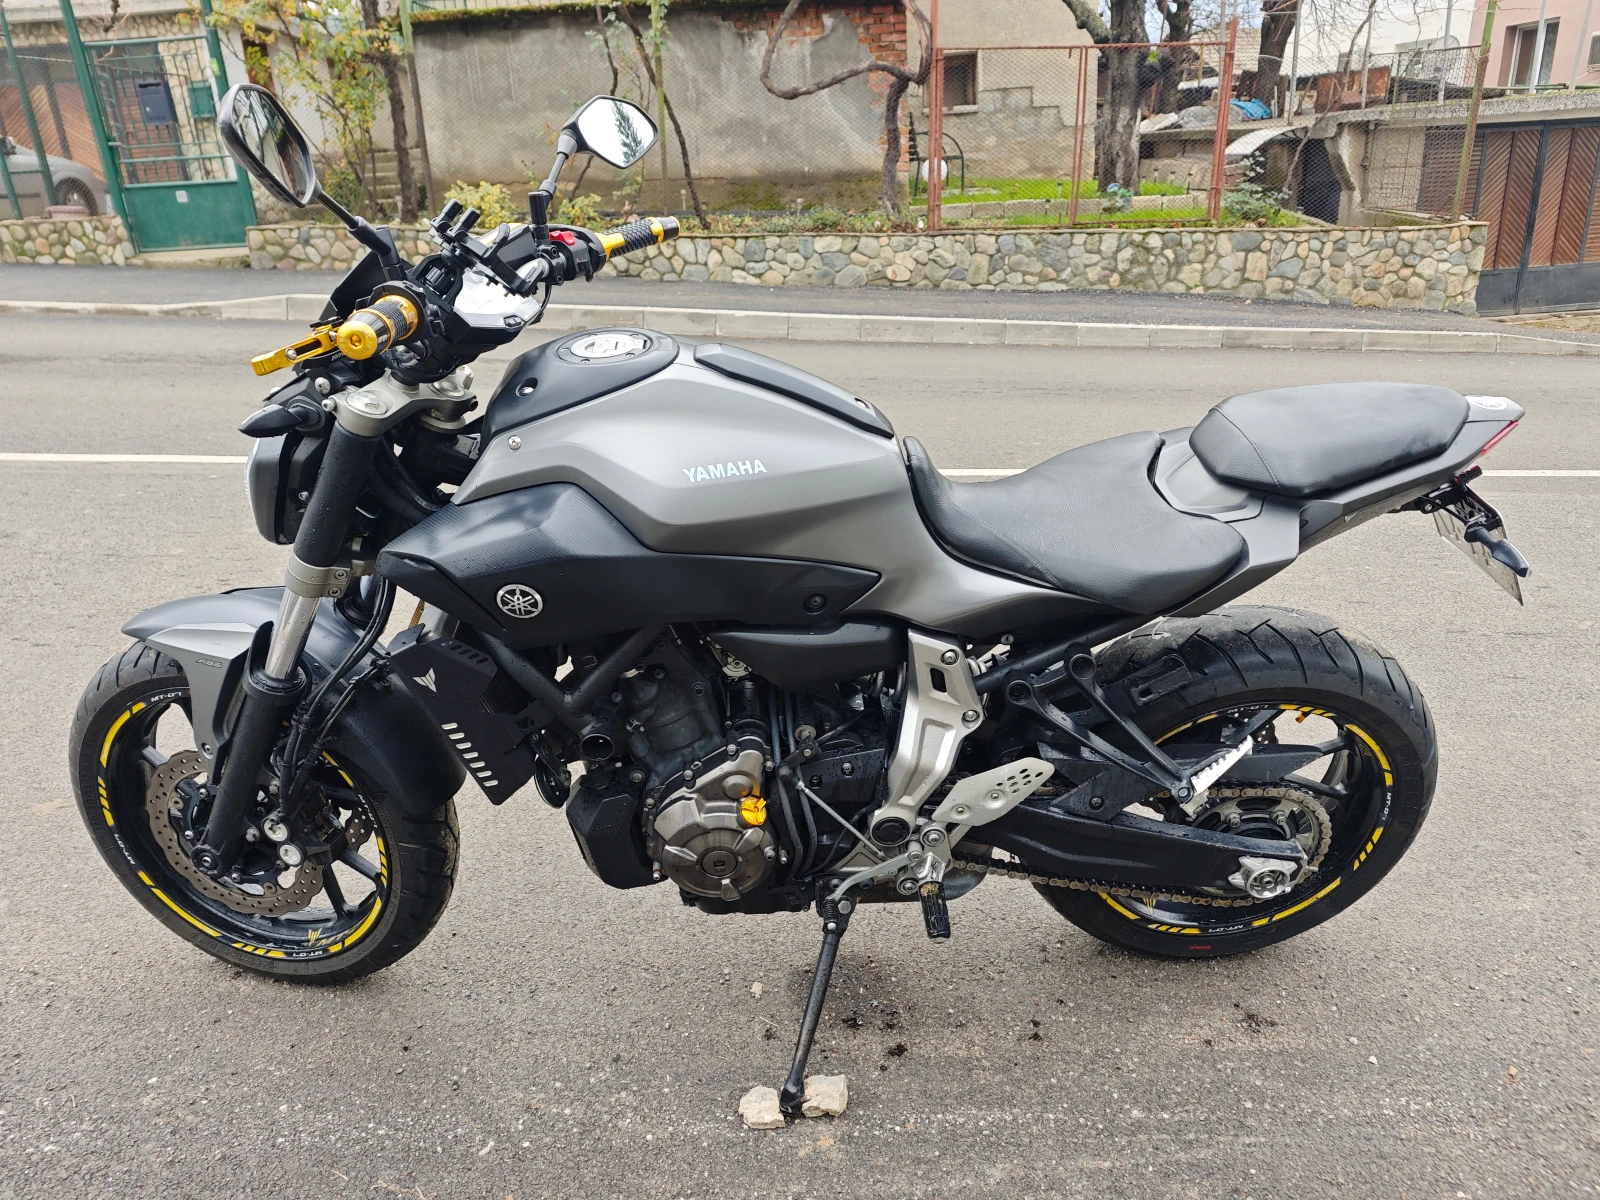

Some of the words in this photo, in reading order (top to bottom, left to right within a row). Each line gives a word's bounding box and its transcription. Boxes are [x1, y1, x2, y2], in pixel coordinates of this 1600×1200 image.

[682, 459, 767, 483] YAMAHA
[151, 691, 182, 702] MT-07
[1381, 792, 1392, 820] MT-07
